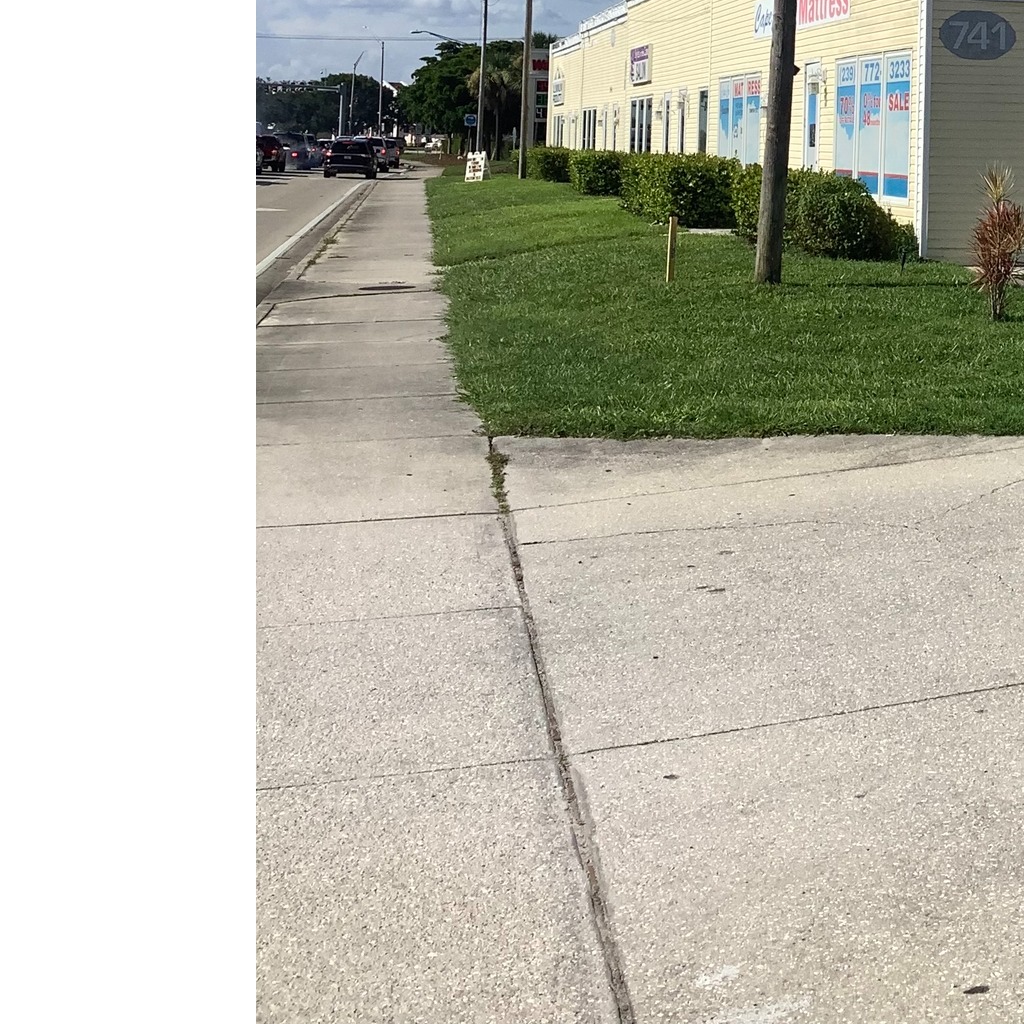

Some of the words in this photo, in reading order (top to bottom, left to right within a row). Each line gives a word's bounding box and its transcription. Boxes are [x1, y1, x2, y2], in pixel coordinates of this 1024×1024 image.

[949, 21, 1006, 50] 741
[889, 59, 911, 79] 3233
[888, 92, 910, 112] SALE
